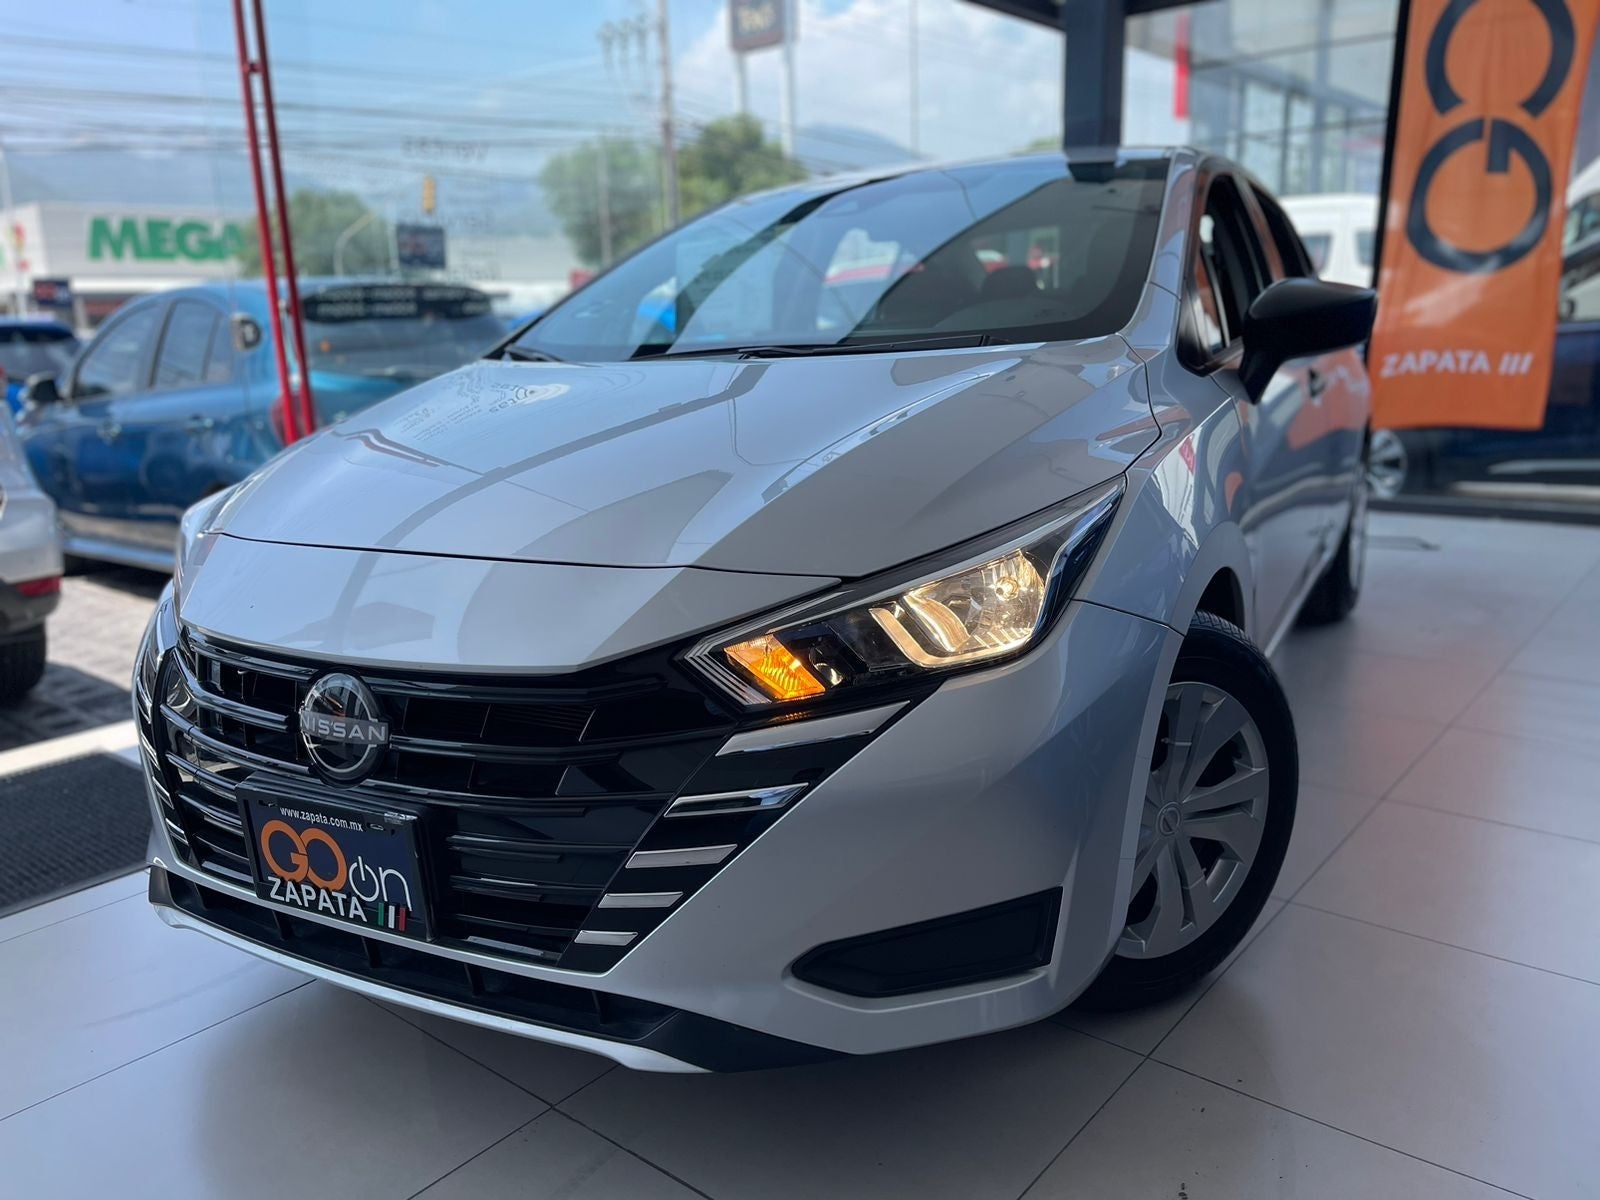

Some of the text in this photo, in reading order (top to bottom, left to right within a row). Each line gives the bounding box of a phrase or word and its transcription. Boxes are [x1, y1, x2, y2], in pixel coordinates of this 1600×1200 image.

[90, 217, 244, 261] MEGA
[1380, 350, 1490, 378] ZAPATA
[300, 713, 387, 742] NISSAN
[280, 806, 364, 832] www.zapata.com.mx
[268, 875, 368, 922] ZAPATA
